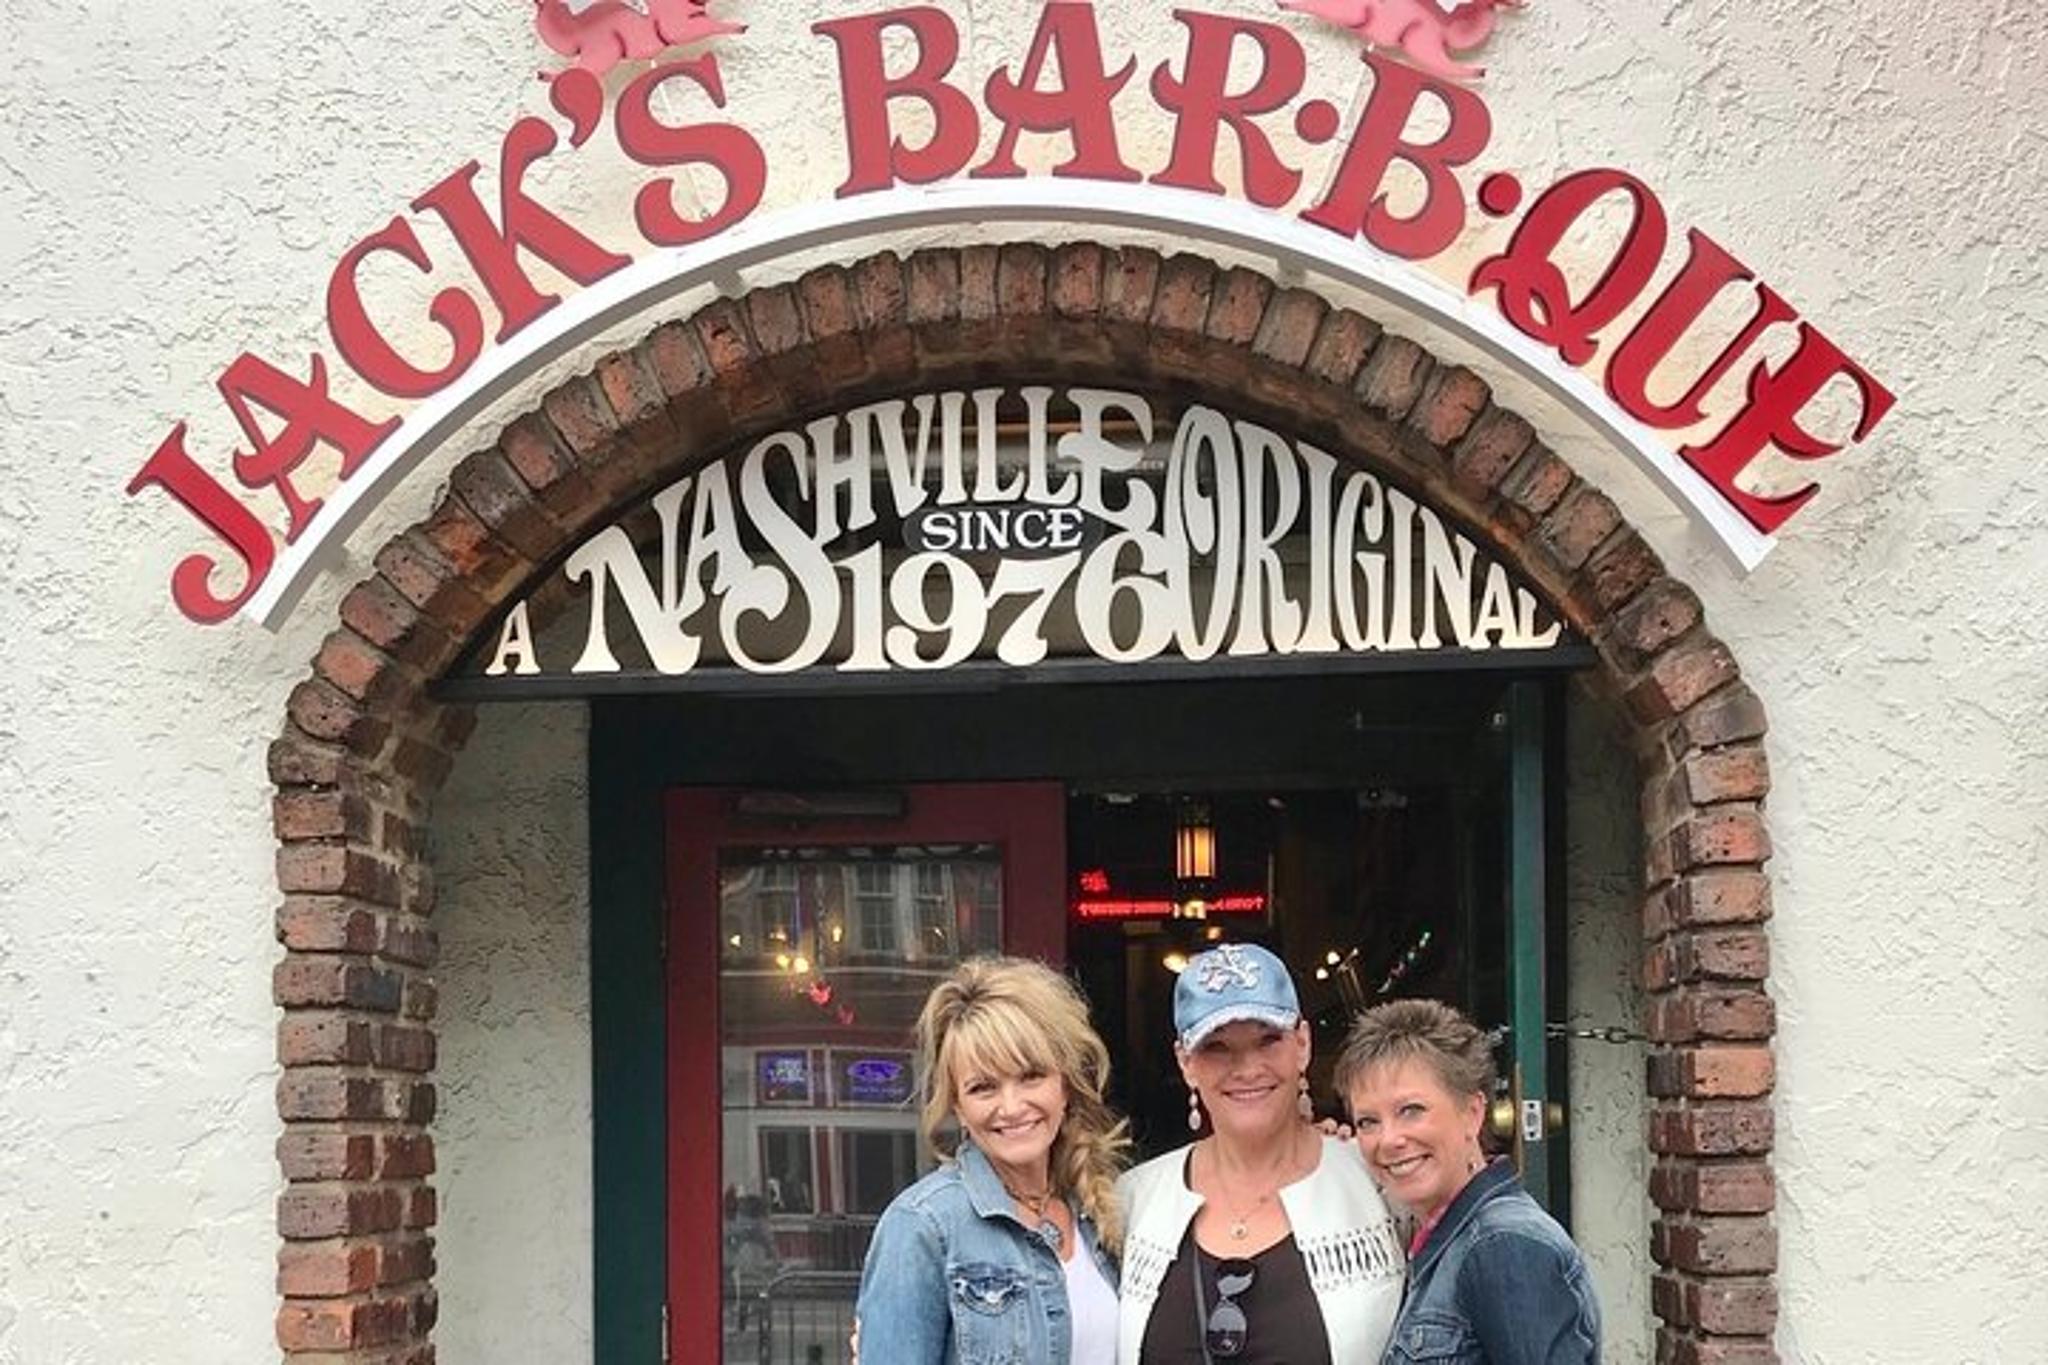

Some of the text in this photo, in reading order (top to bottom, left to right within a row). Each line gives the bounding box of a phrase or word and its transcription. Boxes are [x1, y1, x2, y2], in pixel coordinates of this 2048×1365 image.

[126, 52, 767, 627] JACK'S
[485, 386, 1564, 675] A NASHVILLE ORIGINAL
[832, 530, 1174, 671] 1976
[921, 507, 1085, 550] SINCE
